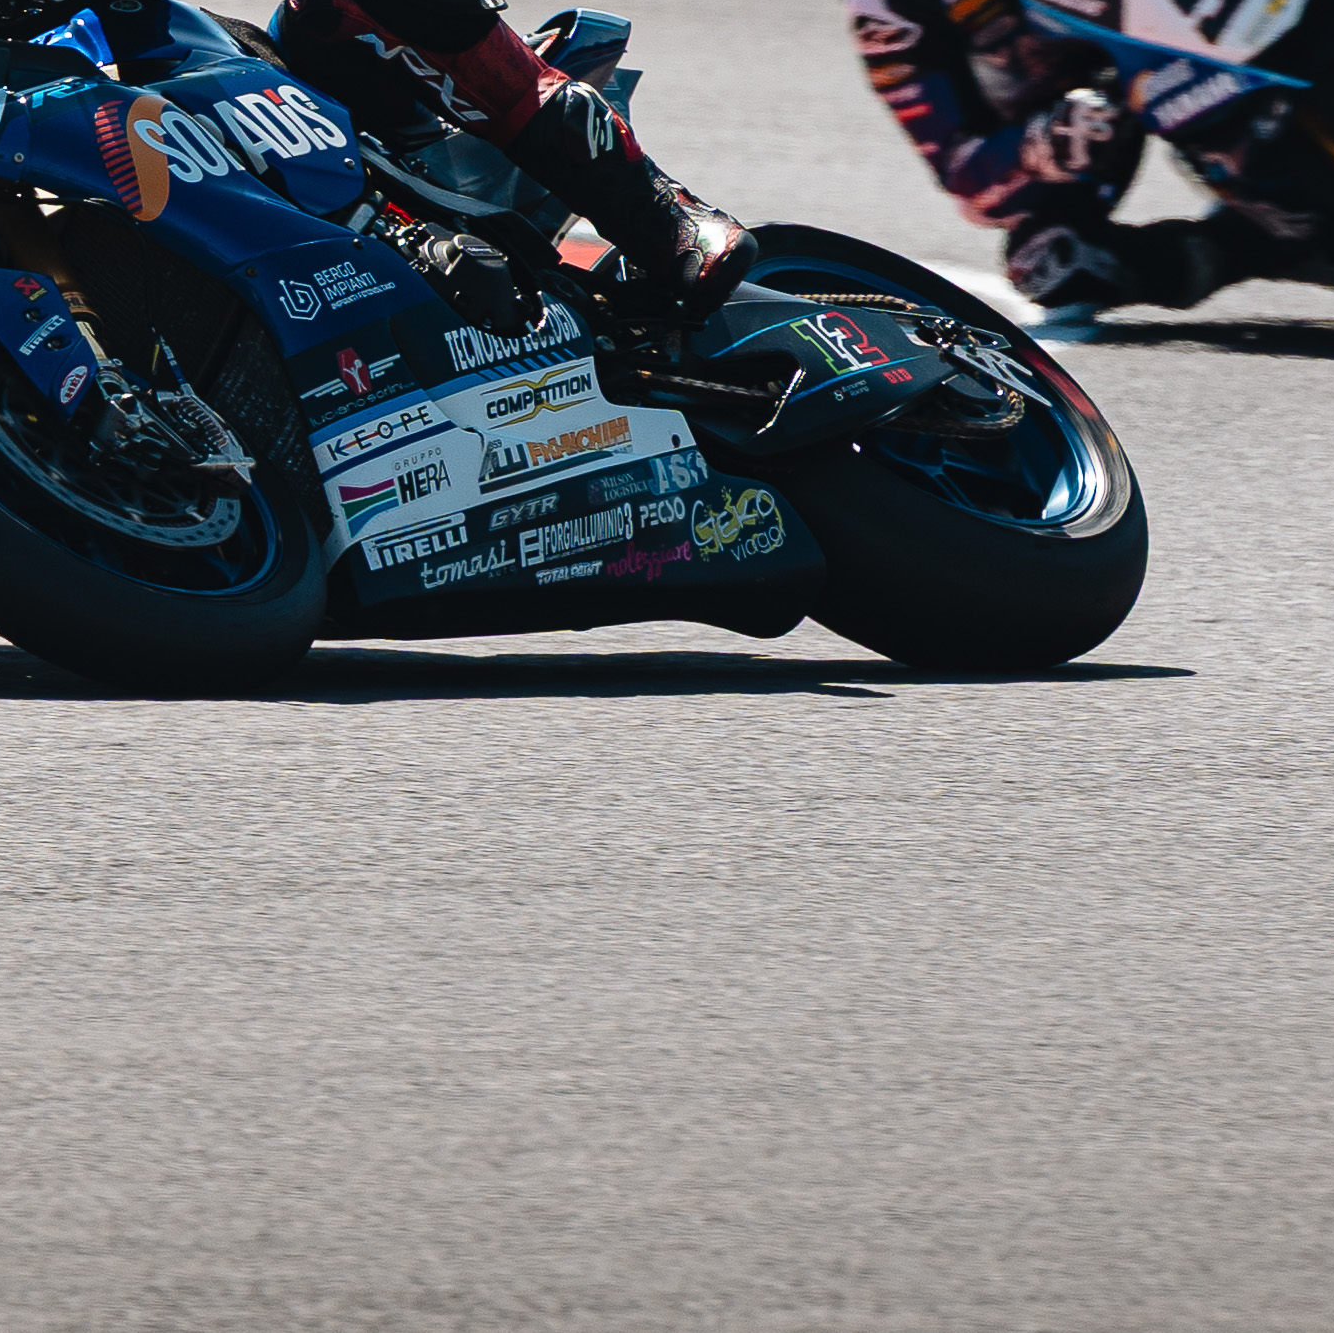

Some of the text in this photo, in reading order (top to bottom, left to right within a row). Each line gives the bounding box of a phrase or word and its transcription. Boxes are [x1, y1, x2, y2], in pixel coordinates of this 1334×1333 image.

[313, 261, 356, 287] BERGO
[322, 272, 377, 302] IMPIANTI
[18, 315, 66, 356] PIRELLI
[789, 311, 890, 375] 12
[486, 373, 592, 419] COMPETITION
[327, 405, 433, 461] KEOPE
[394, 447, 442, 471] GRUPPO
[397, 459, 451, 504] HERA
[490, 494, 560, 530] GYTR
[361, 512, 467, 571] PIRELLI
[420, 539, 516, 589] tomasi
